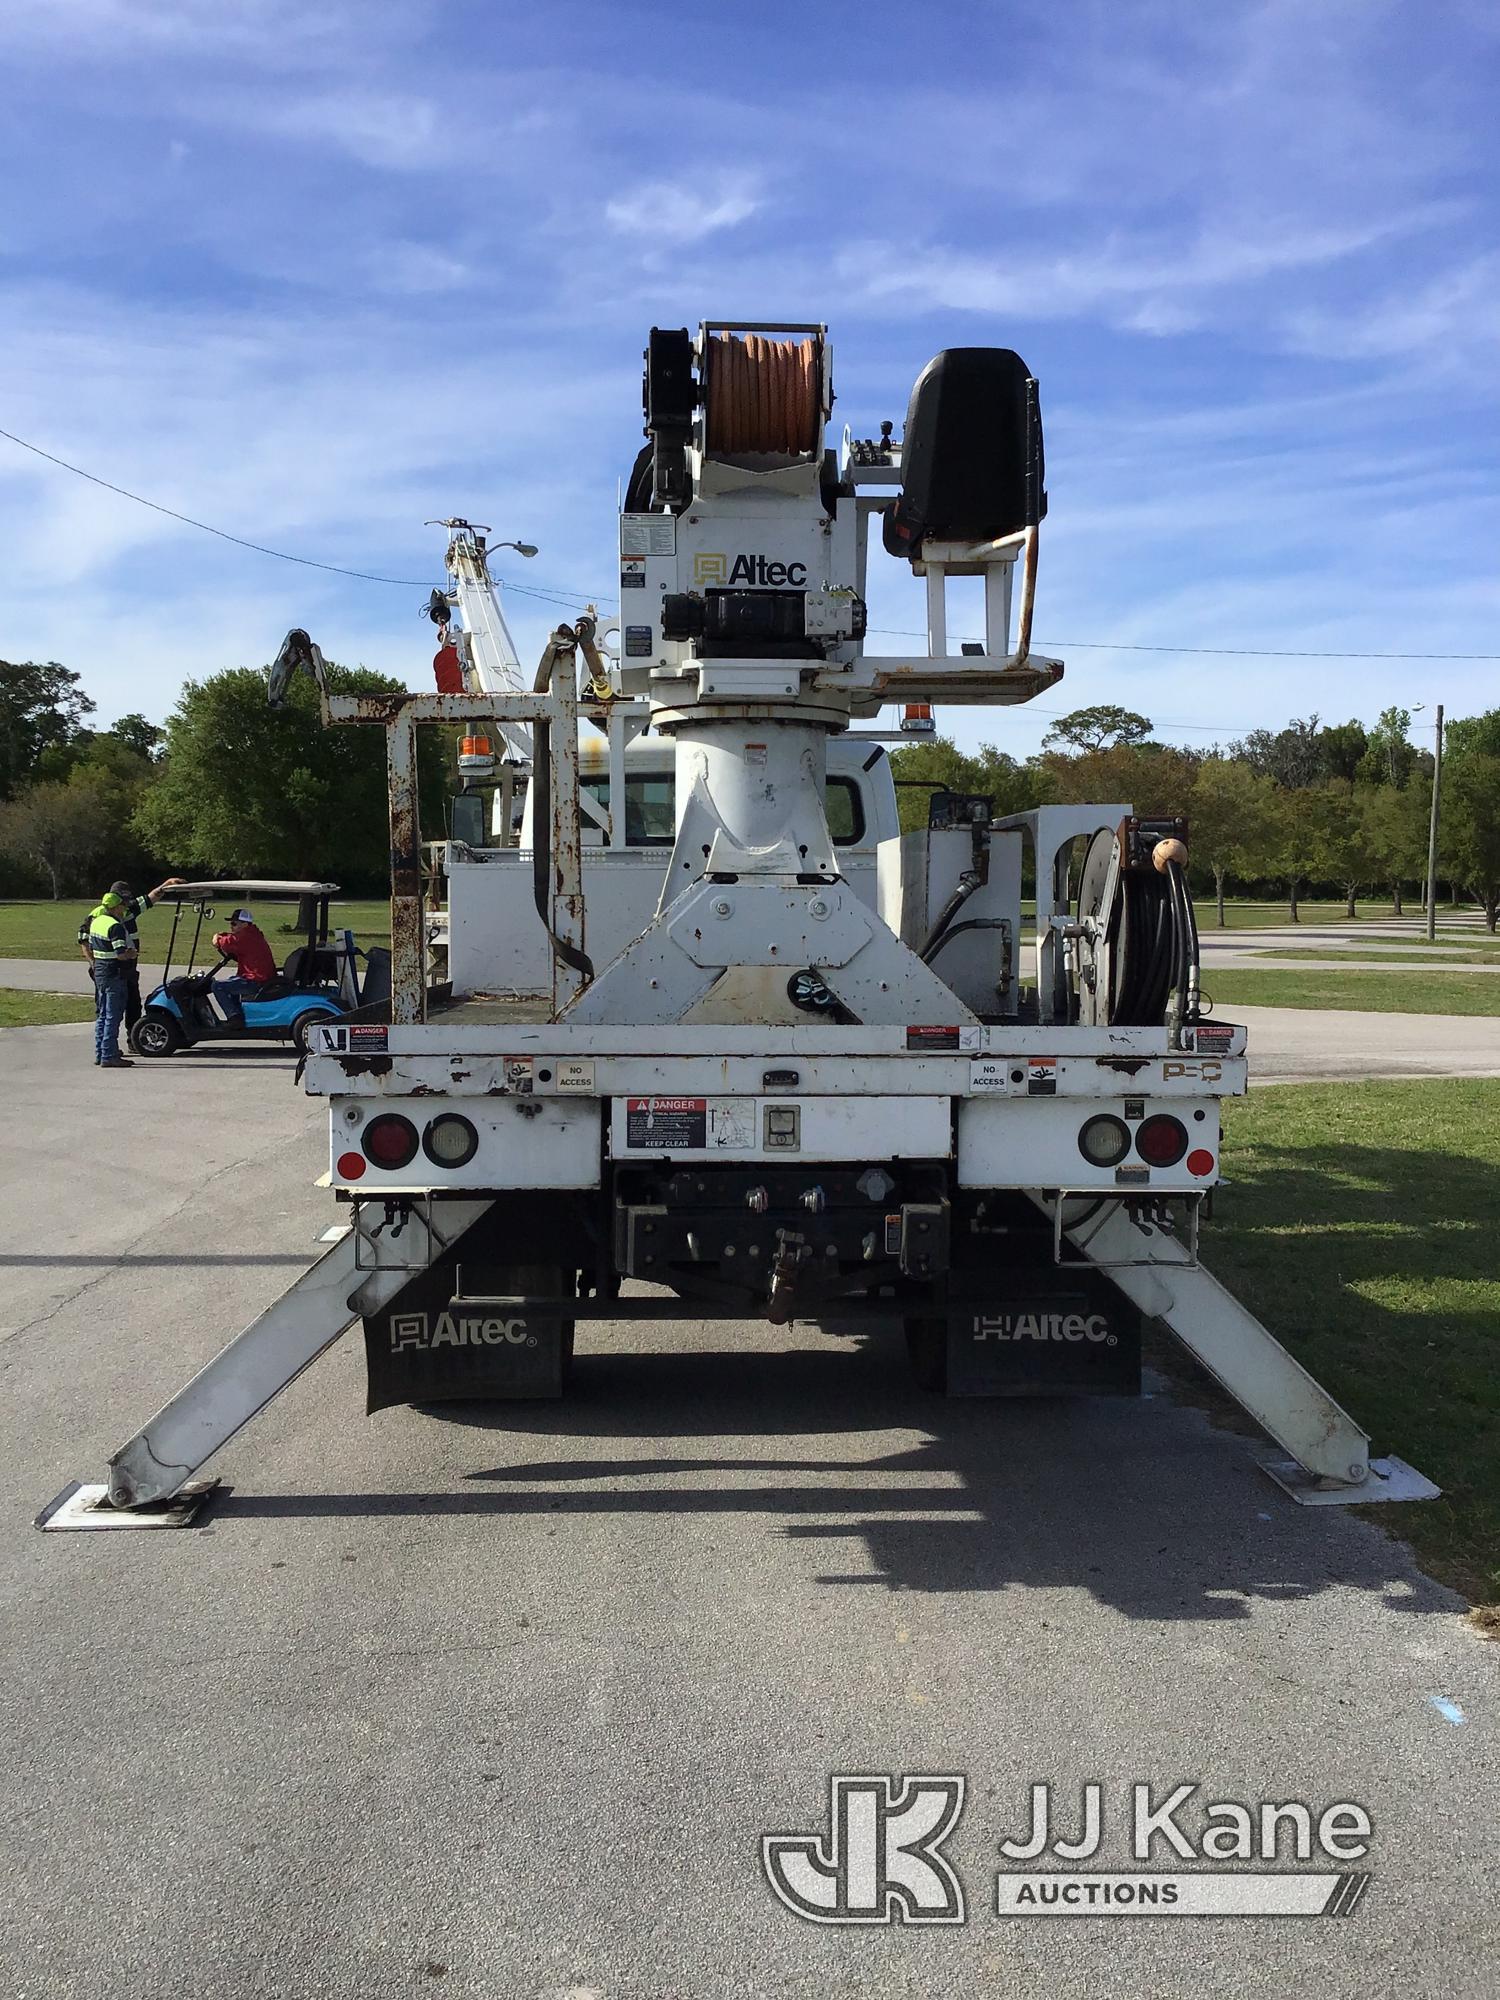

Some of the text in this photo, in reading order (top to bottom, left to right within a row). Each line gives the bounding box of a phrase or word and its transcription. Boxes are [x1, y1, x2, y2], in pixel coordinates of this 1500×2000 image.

[728, 554, 807, 586] Altec
[653, 1100, 695, 1109] DANGER
[430, 1312, 528, 1347] Altec
[1013, 1313, 1108, 1342] Altec
